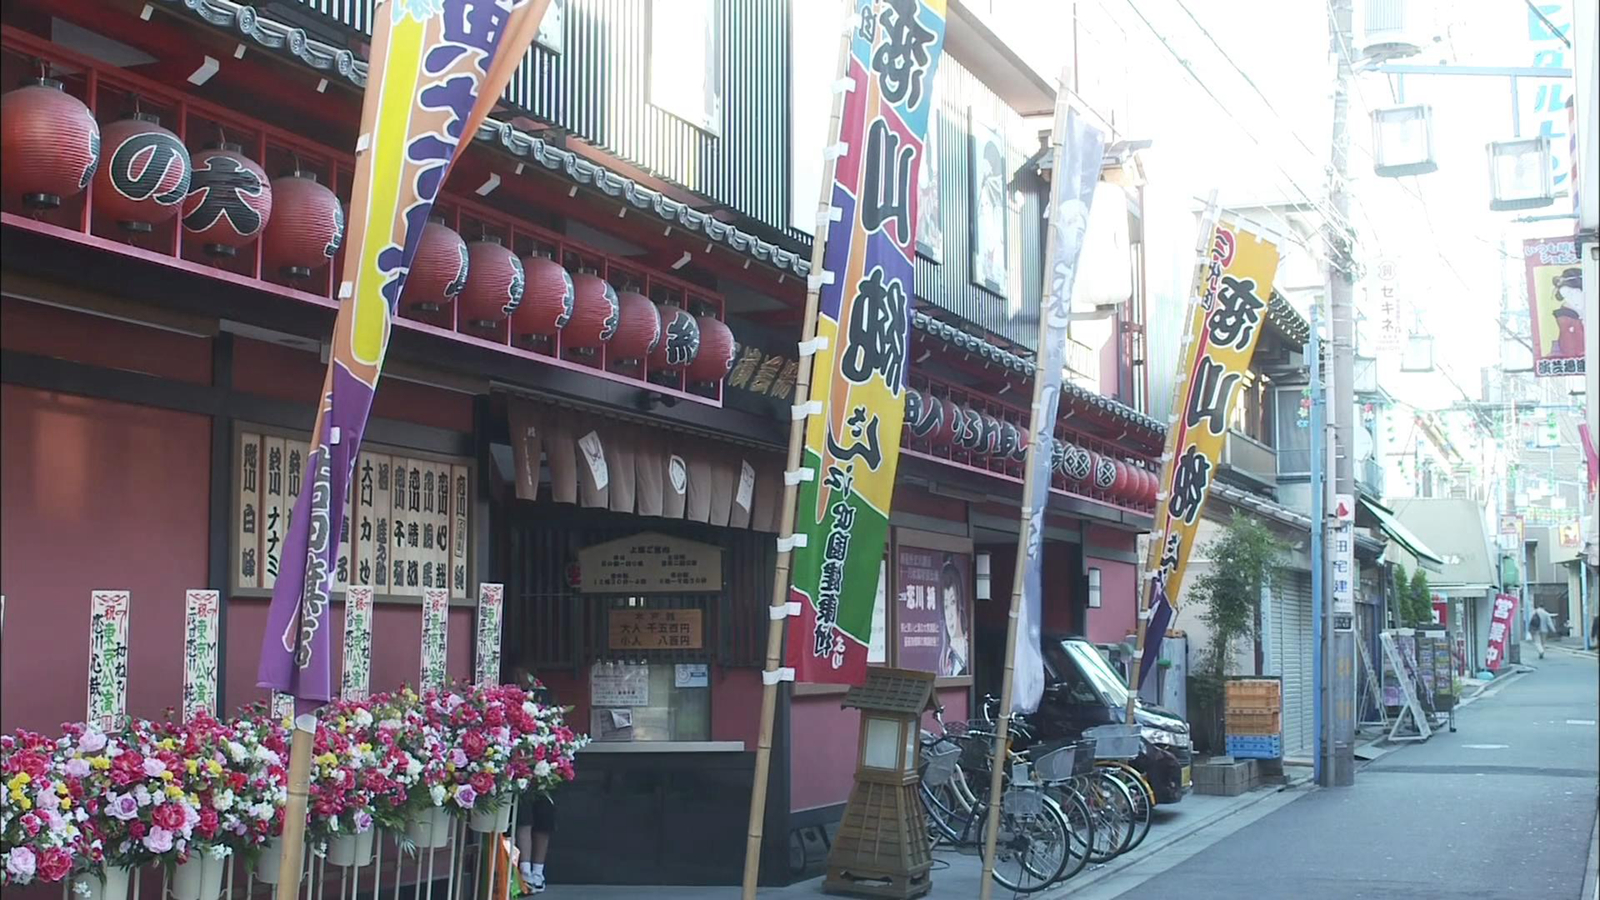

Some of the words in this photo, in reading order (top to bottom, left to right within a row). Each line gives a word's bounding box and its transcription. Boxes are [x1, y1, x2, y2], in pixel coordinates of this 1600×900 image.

[1380, 285, 1395, 333] セキネ
[101, 622, 116, 714] 東京公演
[195, 619, 207, 704] 東京公演
